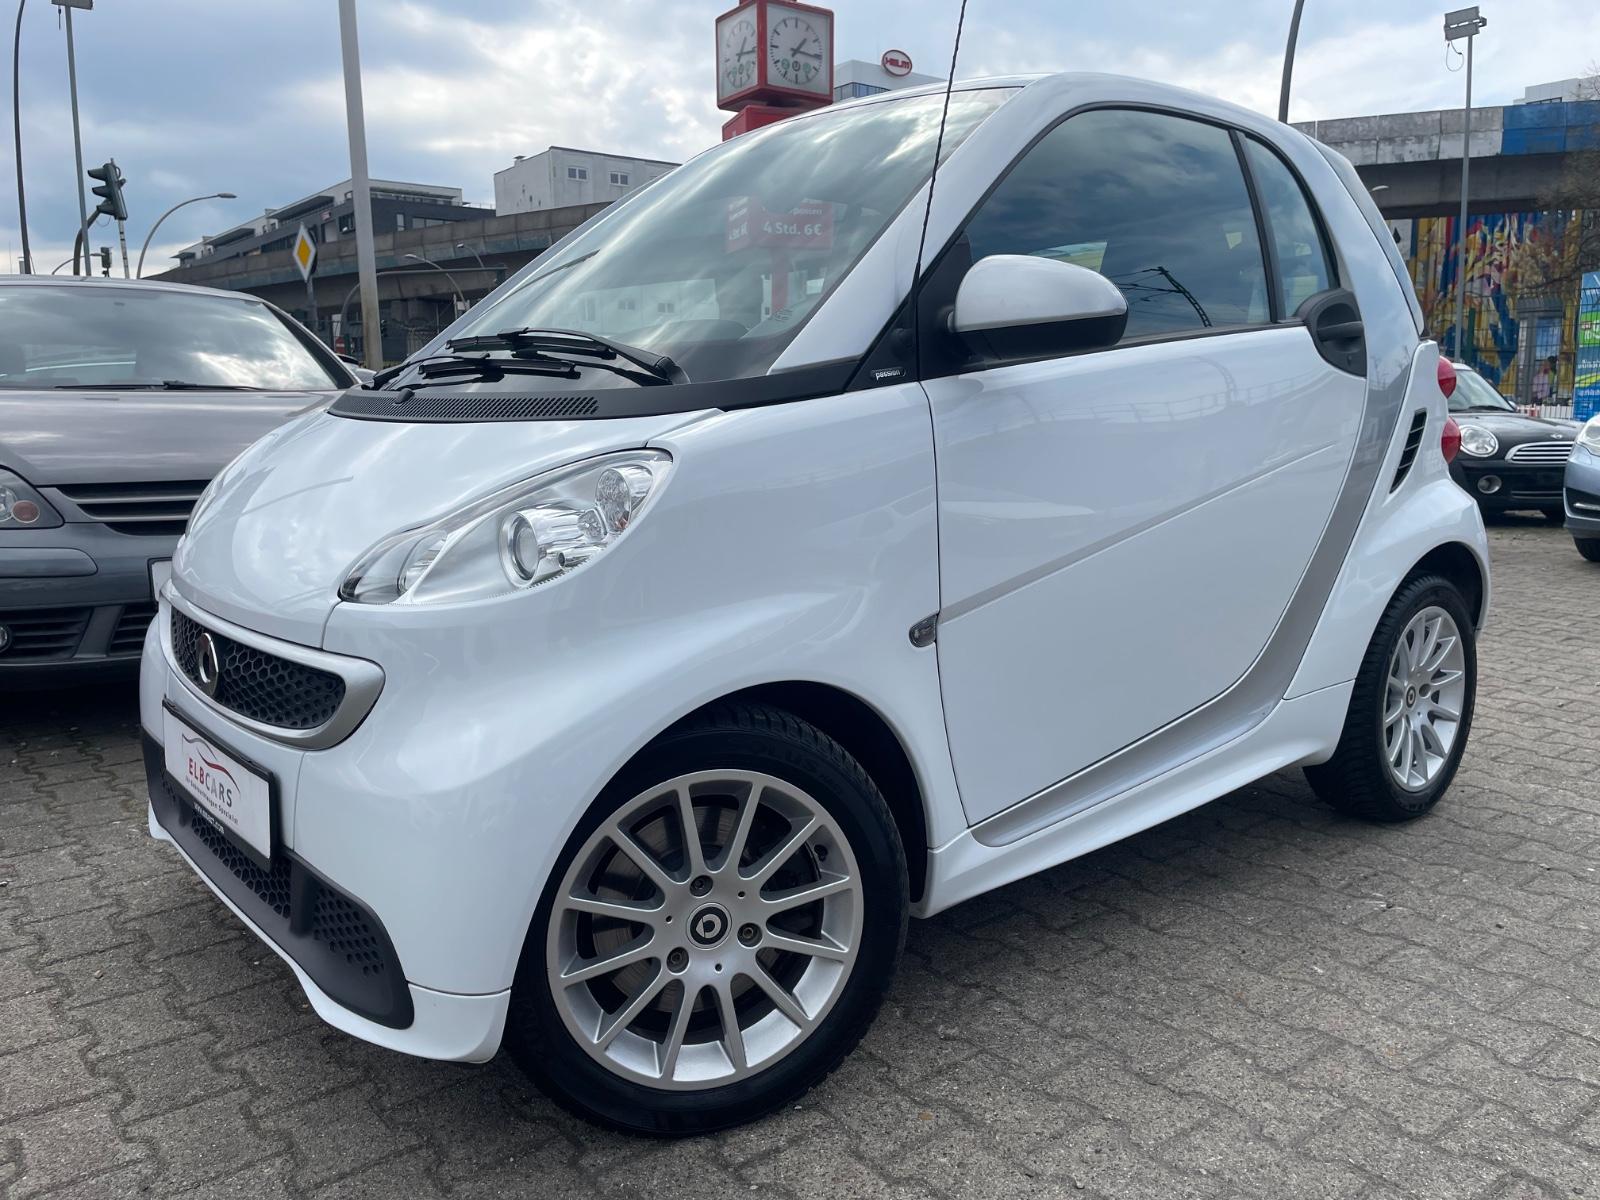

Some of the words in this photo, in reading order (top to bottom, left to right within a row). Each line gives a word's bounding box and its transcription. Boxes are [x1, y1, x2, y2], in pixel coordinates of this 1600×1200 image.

[763, 221, 772, 234] 4
[775, 222, 801, 235] Std.
[875, 369, 901, 381] passion
[188, 758, 232, 808] ELBCARS
